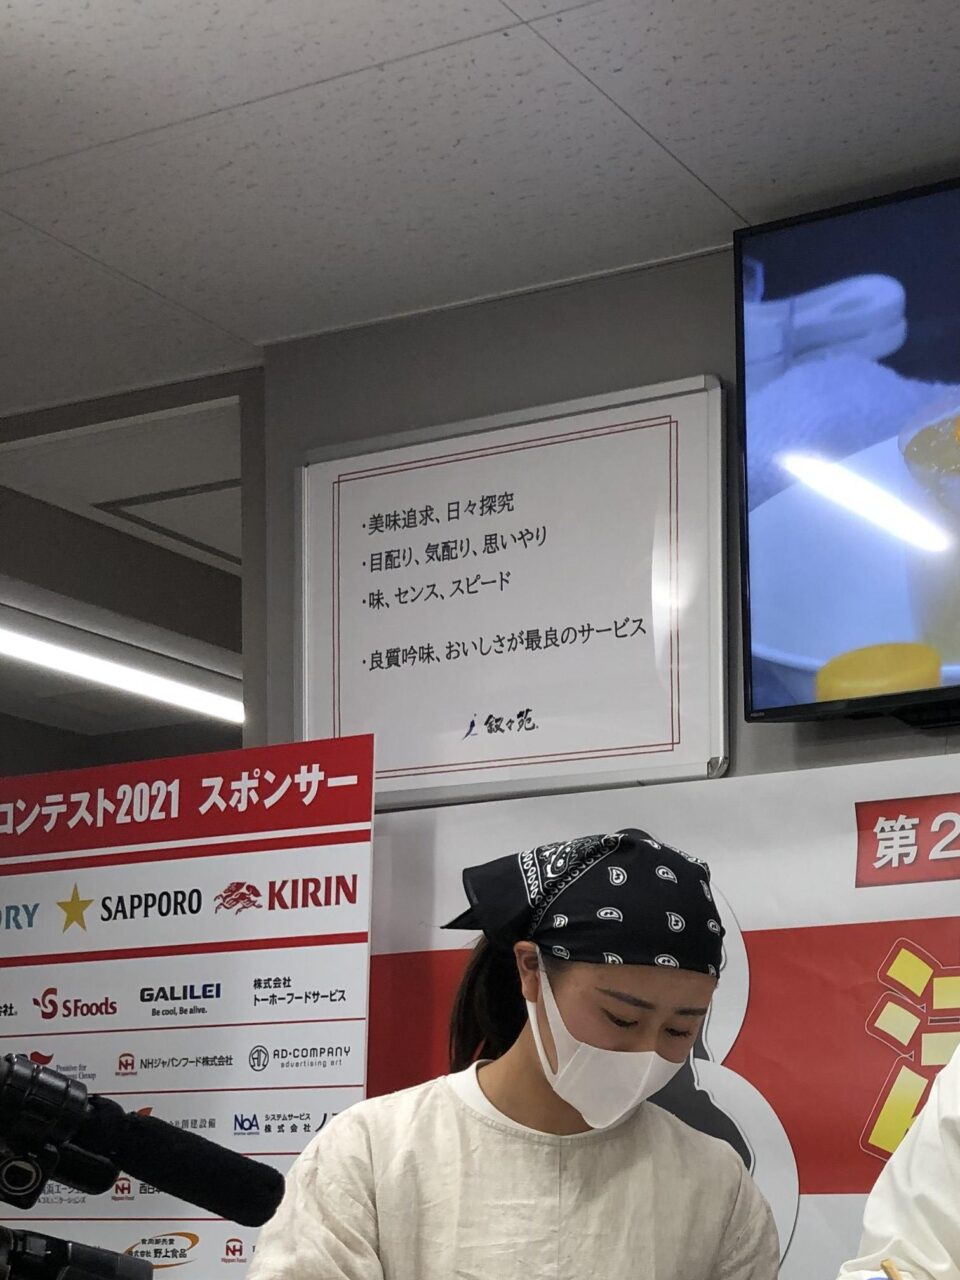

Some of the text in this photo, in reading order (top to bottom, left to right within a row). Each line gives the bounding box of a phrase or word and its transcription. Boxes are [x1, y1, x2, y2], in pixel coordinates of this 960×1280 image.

[199, 763, 358, 816] スポンサー
[0, 873, 358, 930] RY SAPPORO KIRIN
[253, 976, 292, 990] 株式会社
[140, 982, 221, 1003] GALILEI
[253, 989, 346, 1007] トーホーフードサービス
[140, 1055, 233, 1069] NHジャパンフード株式会社
[265, 1113, 311, 1122] システムサービス
[153, 1247, 188, 1259] 野上食品
